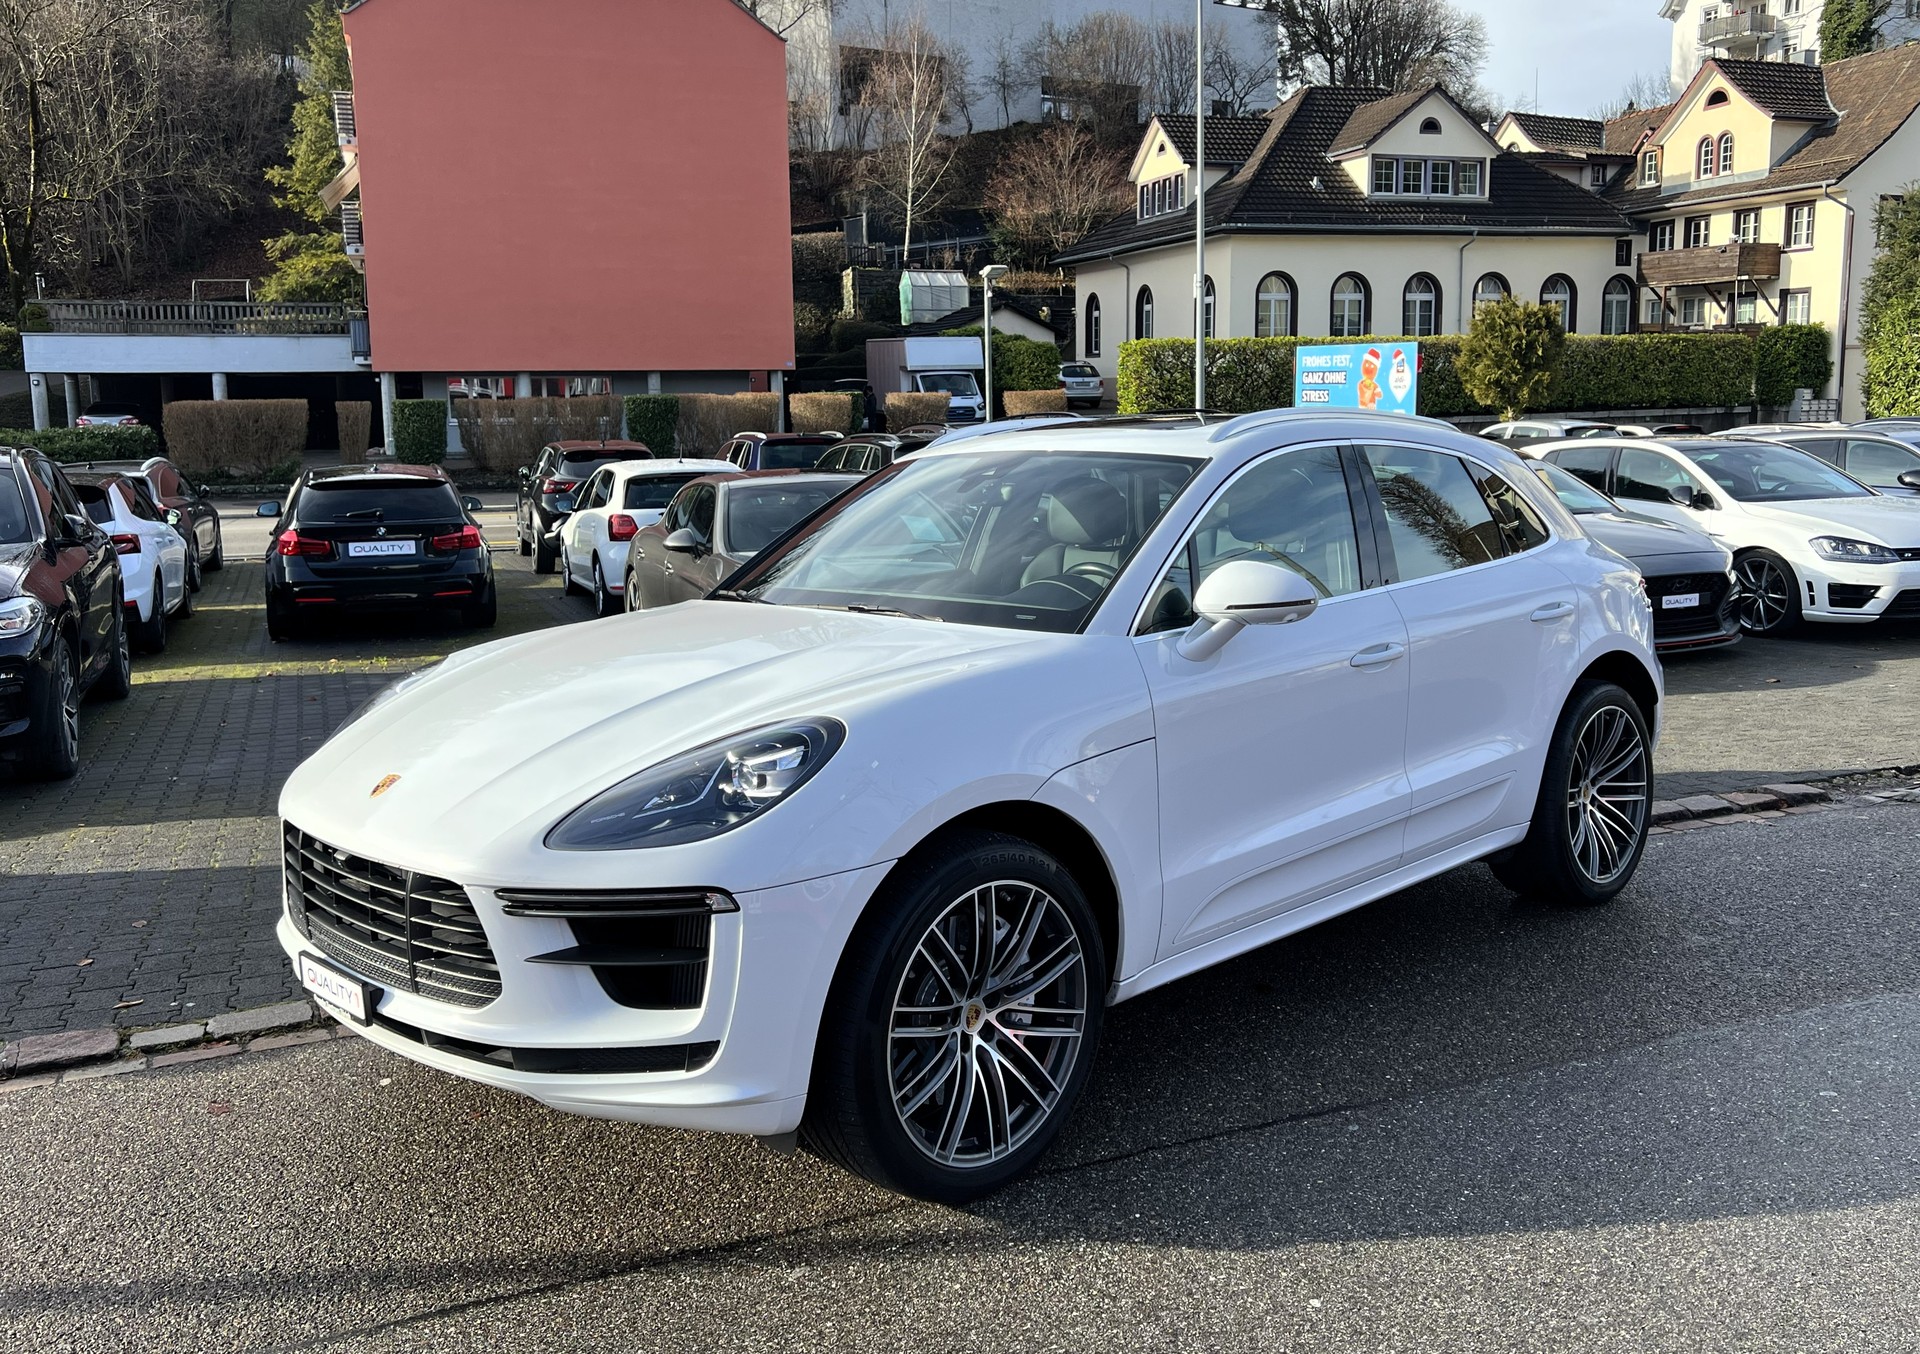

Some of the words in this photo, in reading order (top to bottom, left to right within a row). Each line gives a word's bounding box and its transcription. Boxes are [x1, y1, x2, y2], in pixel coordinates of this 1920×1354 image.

[1302, 355, 1331, 367] FROHES
[1302, 371, 1323, 384] GANZ
[1324, 371, 1347, 384] OHNE
[1302, 390, 1329, 402] STRESS
[981, 852, 1026, 866] 265/40
